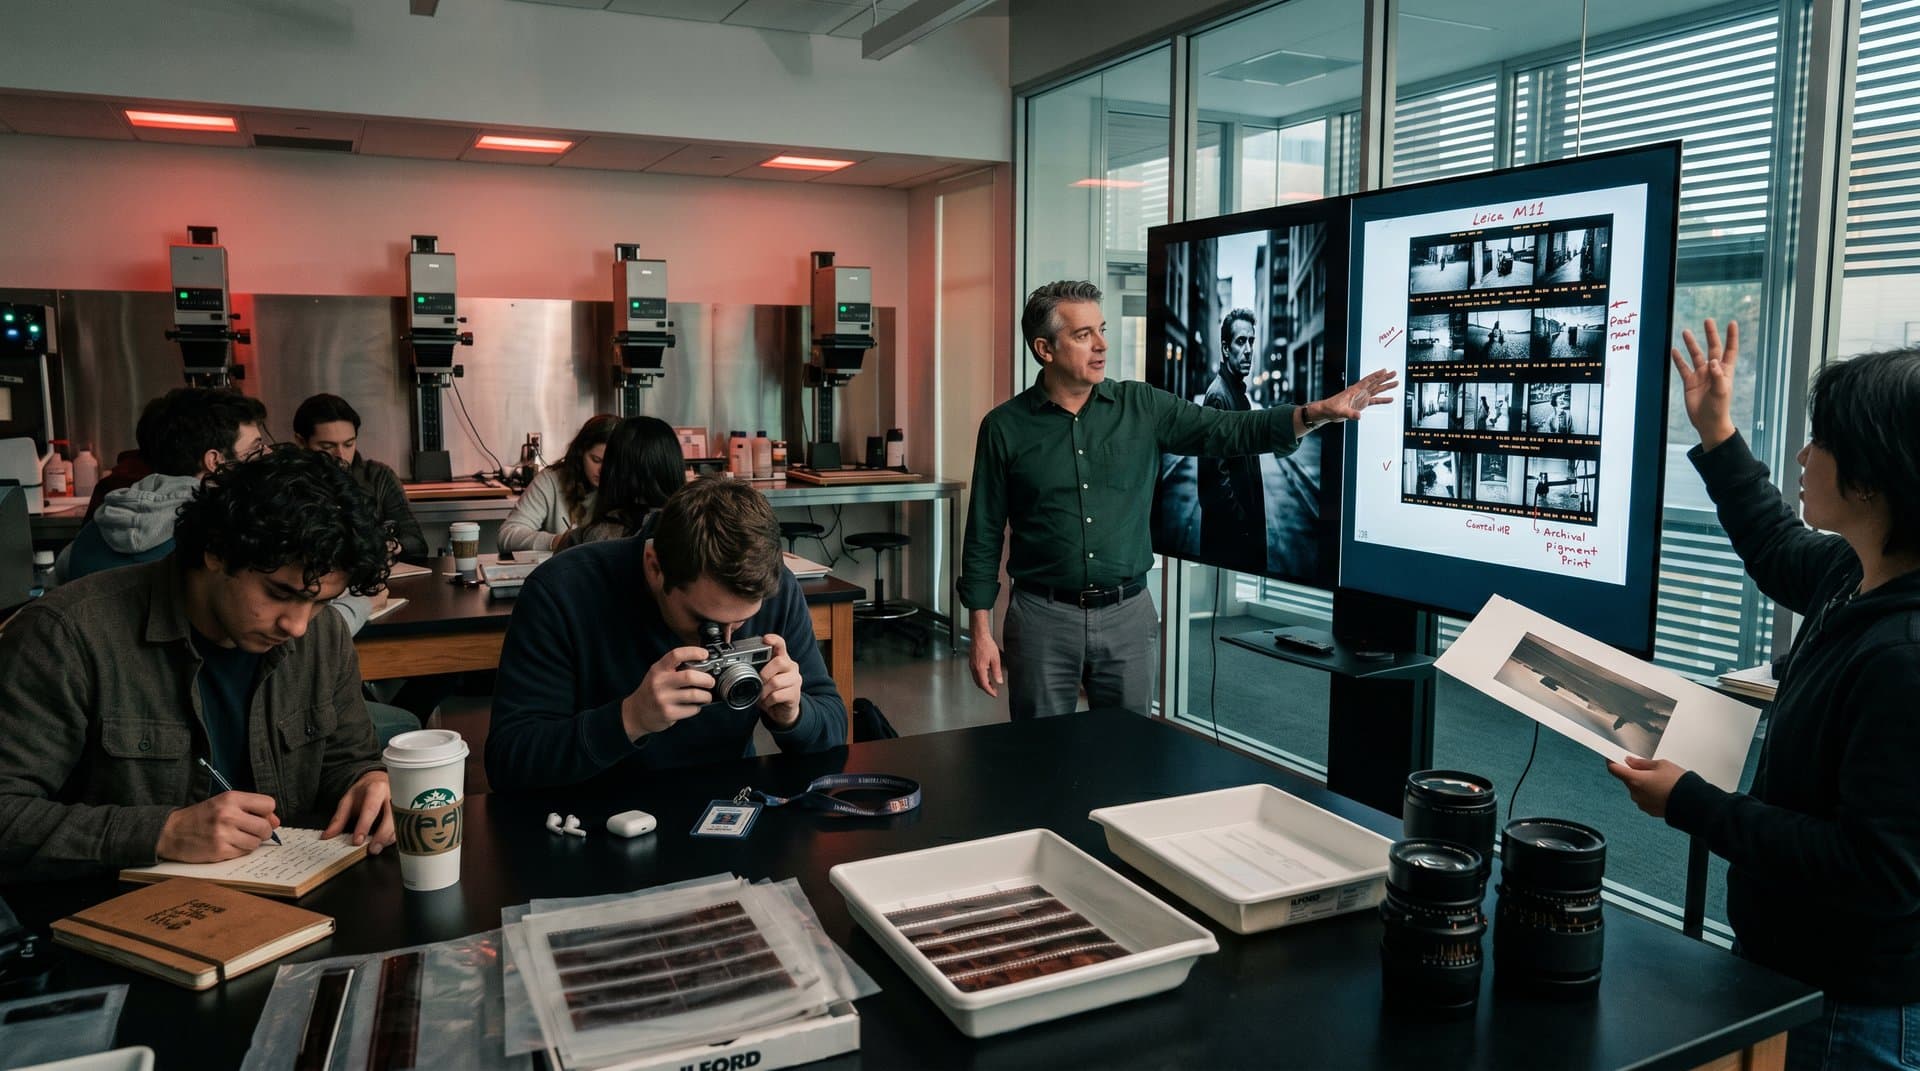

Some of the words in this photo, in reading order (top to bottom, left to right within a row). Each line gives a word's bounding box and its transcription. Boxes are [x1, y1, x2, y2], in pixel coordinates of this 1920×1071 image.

[1473, 212, 1504, 226] Leica
[1512, 201, 1544, 219] M11
[1543, 527, 1586, 542] Archival
[1561, 555, 1591, 568] Print
